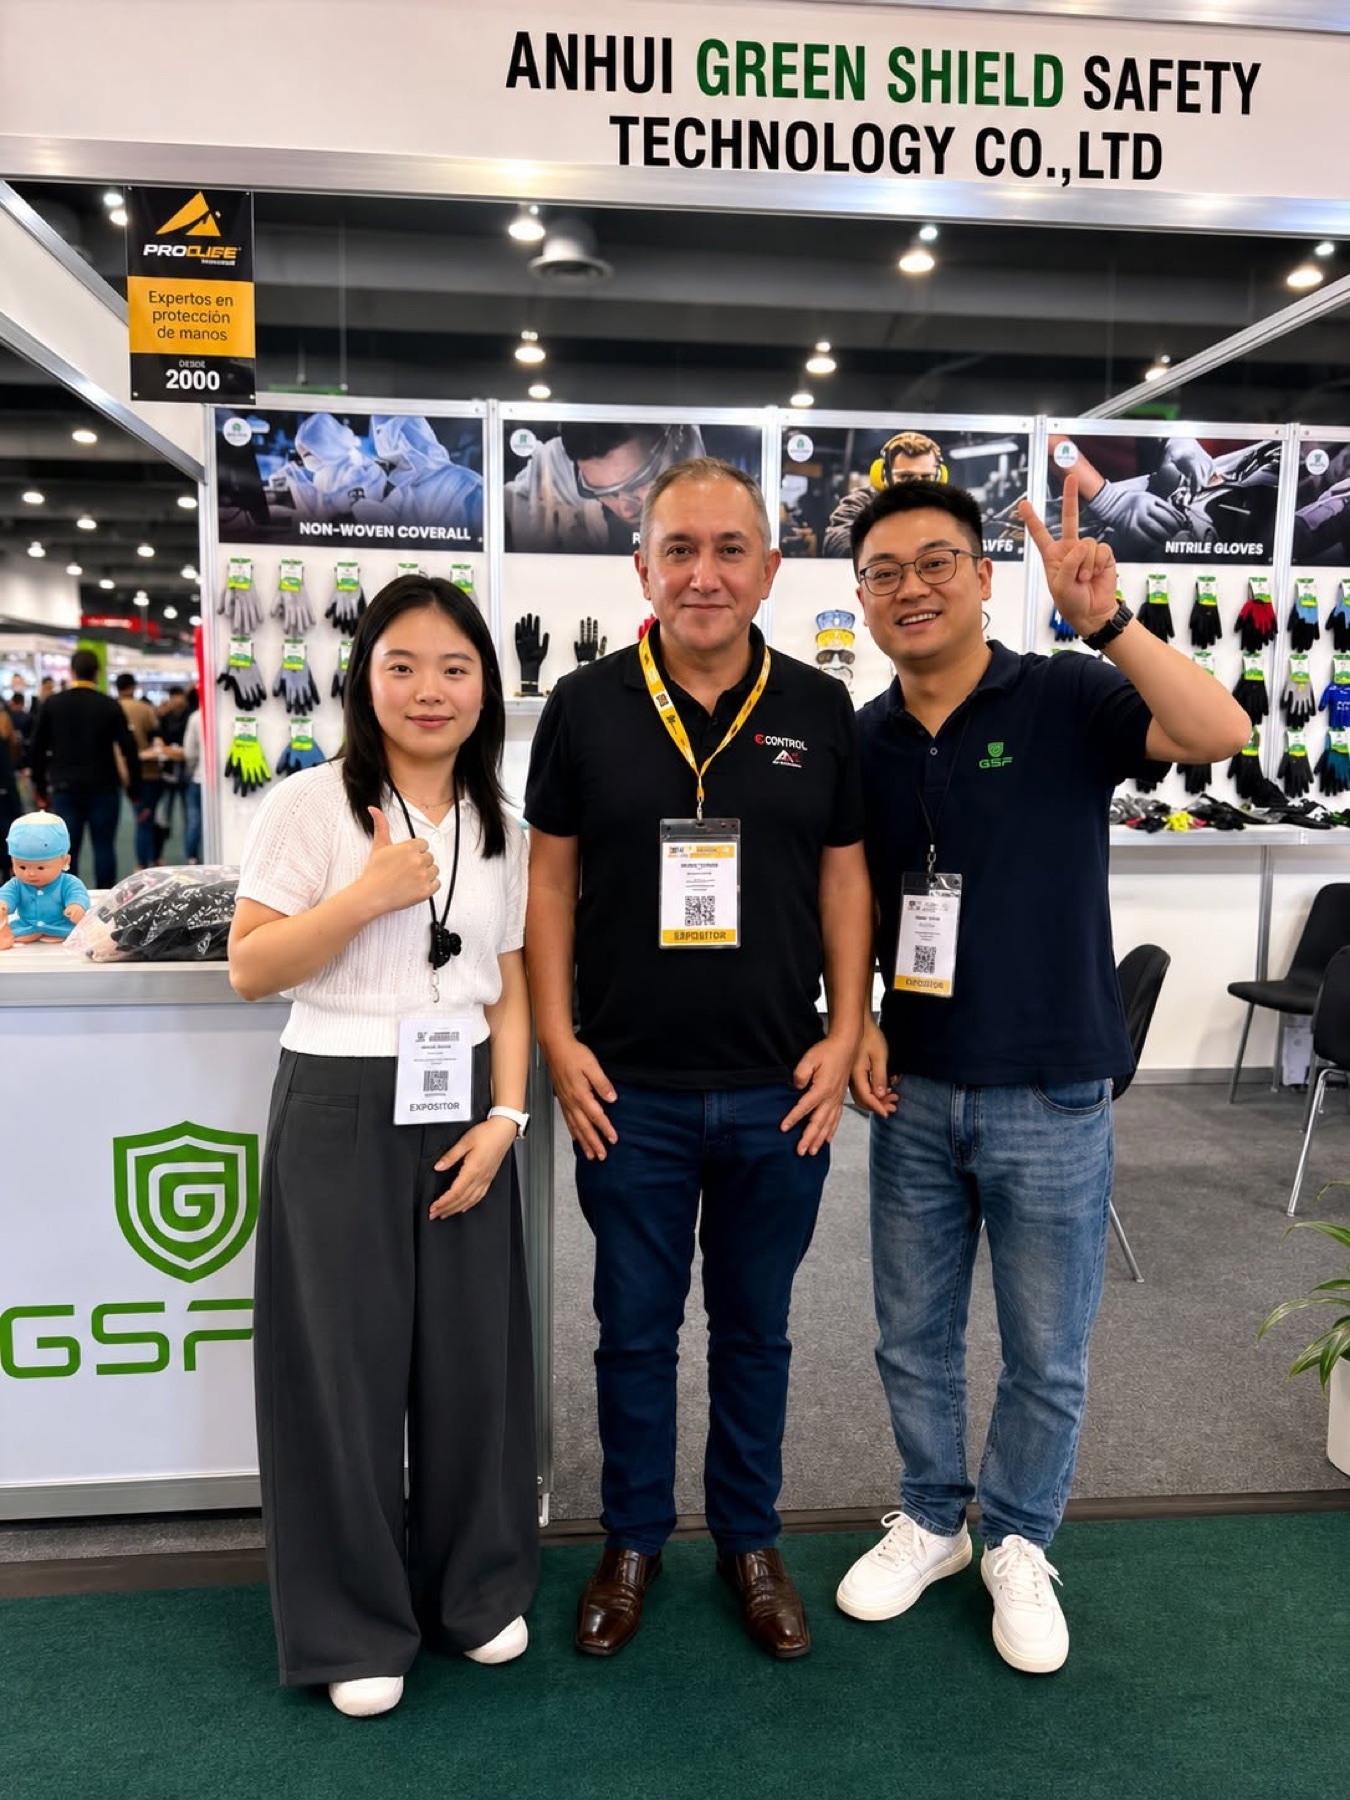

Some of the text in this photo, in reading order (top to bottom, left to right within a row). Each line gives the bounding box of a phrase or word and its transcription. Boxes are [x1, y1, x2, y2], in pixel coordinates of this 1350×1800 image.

[506, 31, 1262, 115] ANHUI GREEN SHIELD SAFETY
[610, 115, 1163, 186] TECHNOLOGY CO.,LTD
[149, 290, 233, 308] Expertos en
[152, 309, 231, 325] protección
[157, 326, 227, 341] de manos
[166, 369, 220, 390] 2000
[299, 521, 472, 541] NON-WOVEN COVERALL
[1165, 541, 1263, 555] NITRILE GLOVES
[409, 1102, 461, 1112] EXPOSITOR
